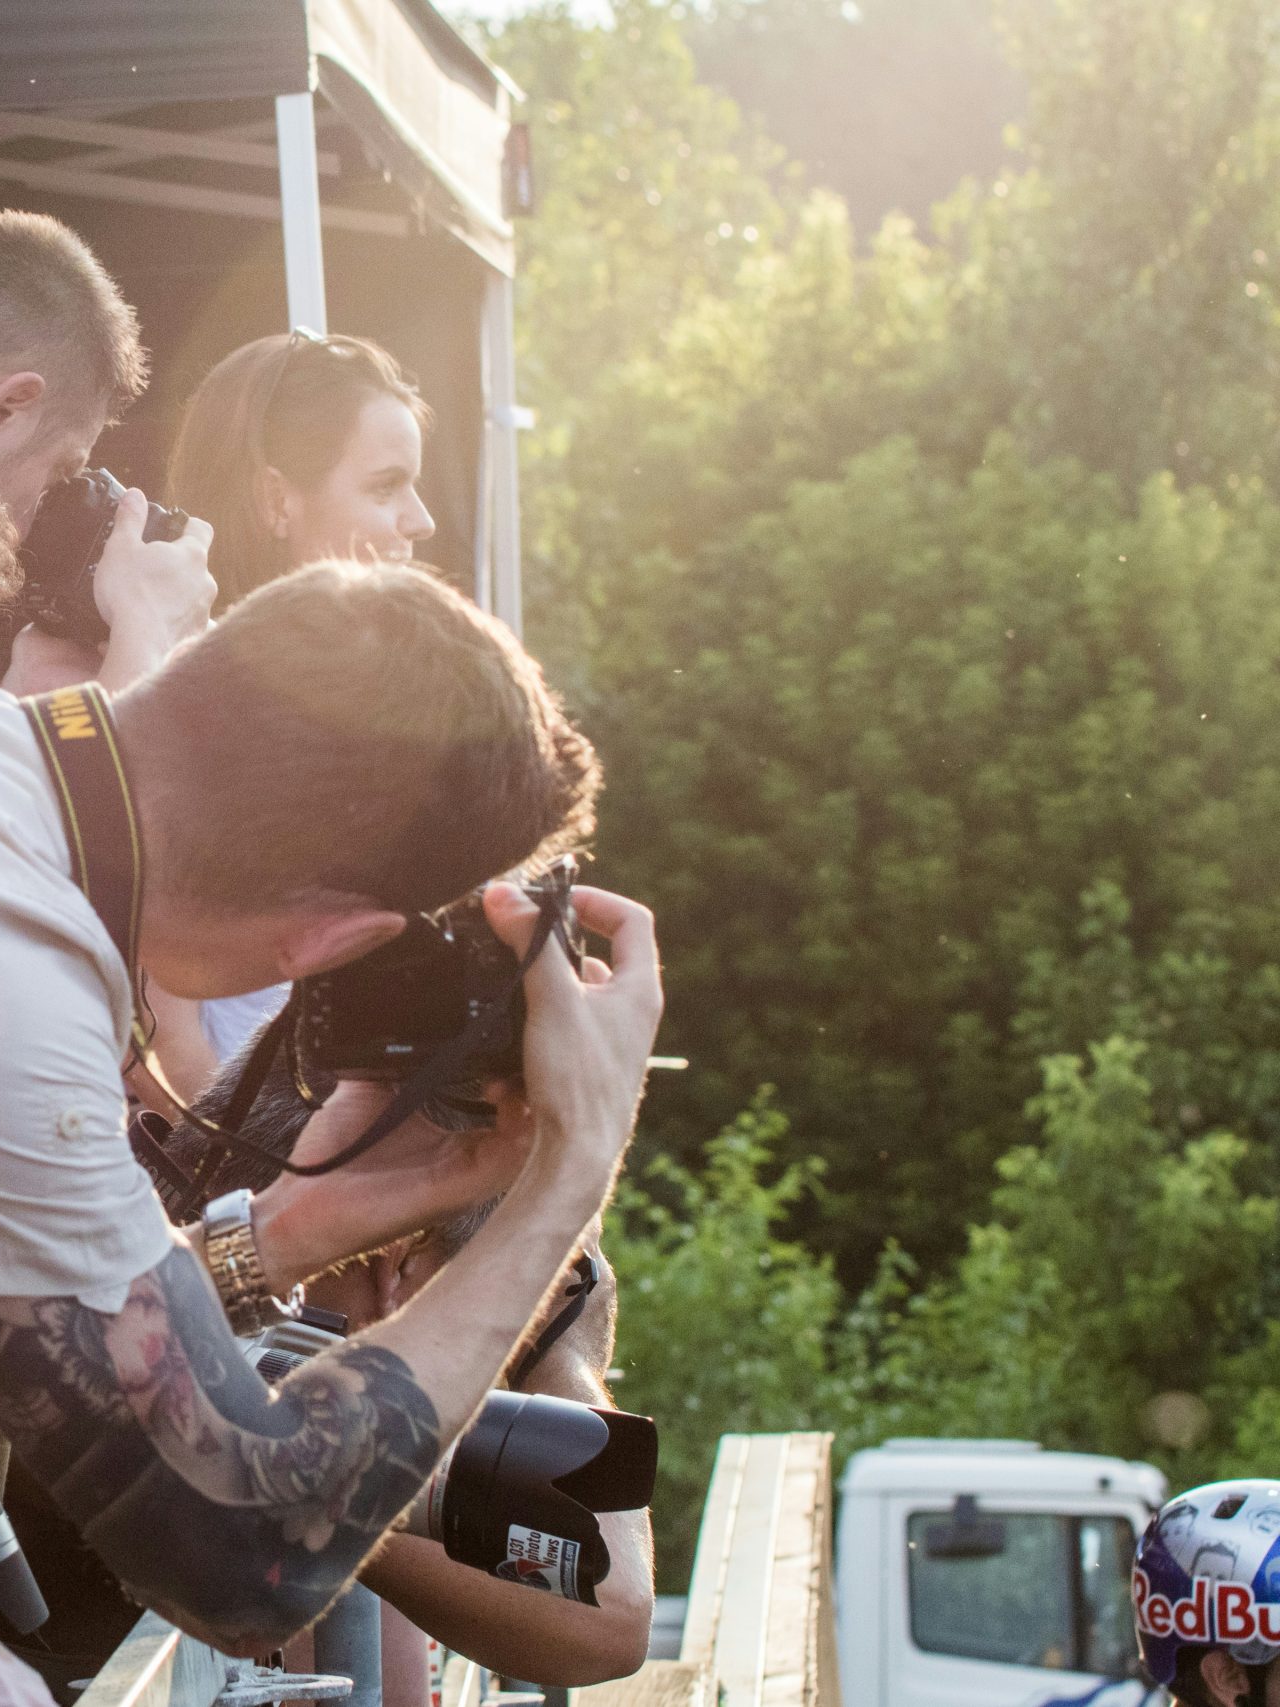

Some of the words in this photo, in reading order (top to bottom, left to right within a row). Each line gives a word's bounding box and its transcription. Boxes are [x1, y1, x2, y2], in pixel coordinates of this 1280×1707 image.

[509, 1538, 524, 1557] 031
[525, 1531, 542, 1563] photo
[543, 1538, 560, 1567] News
